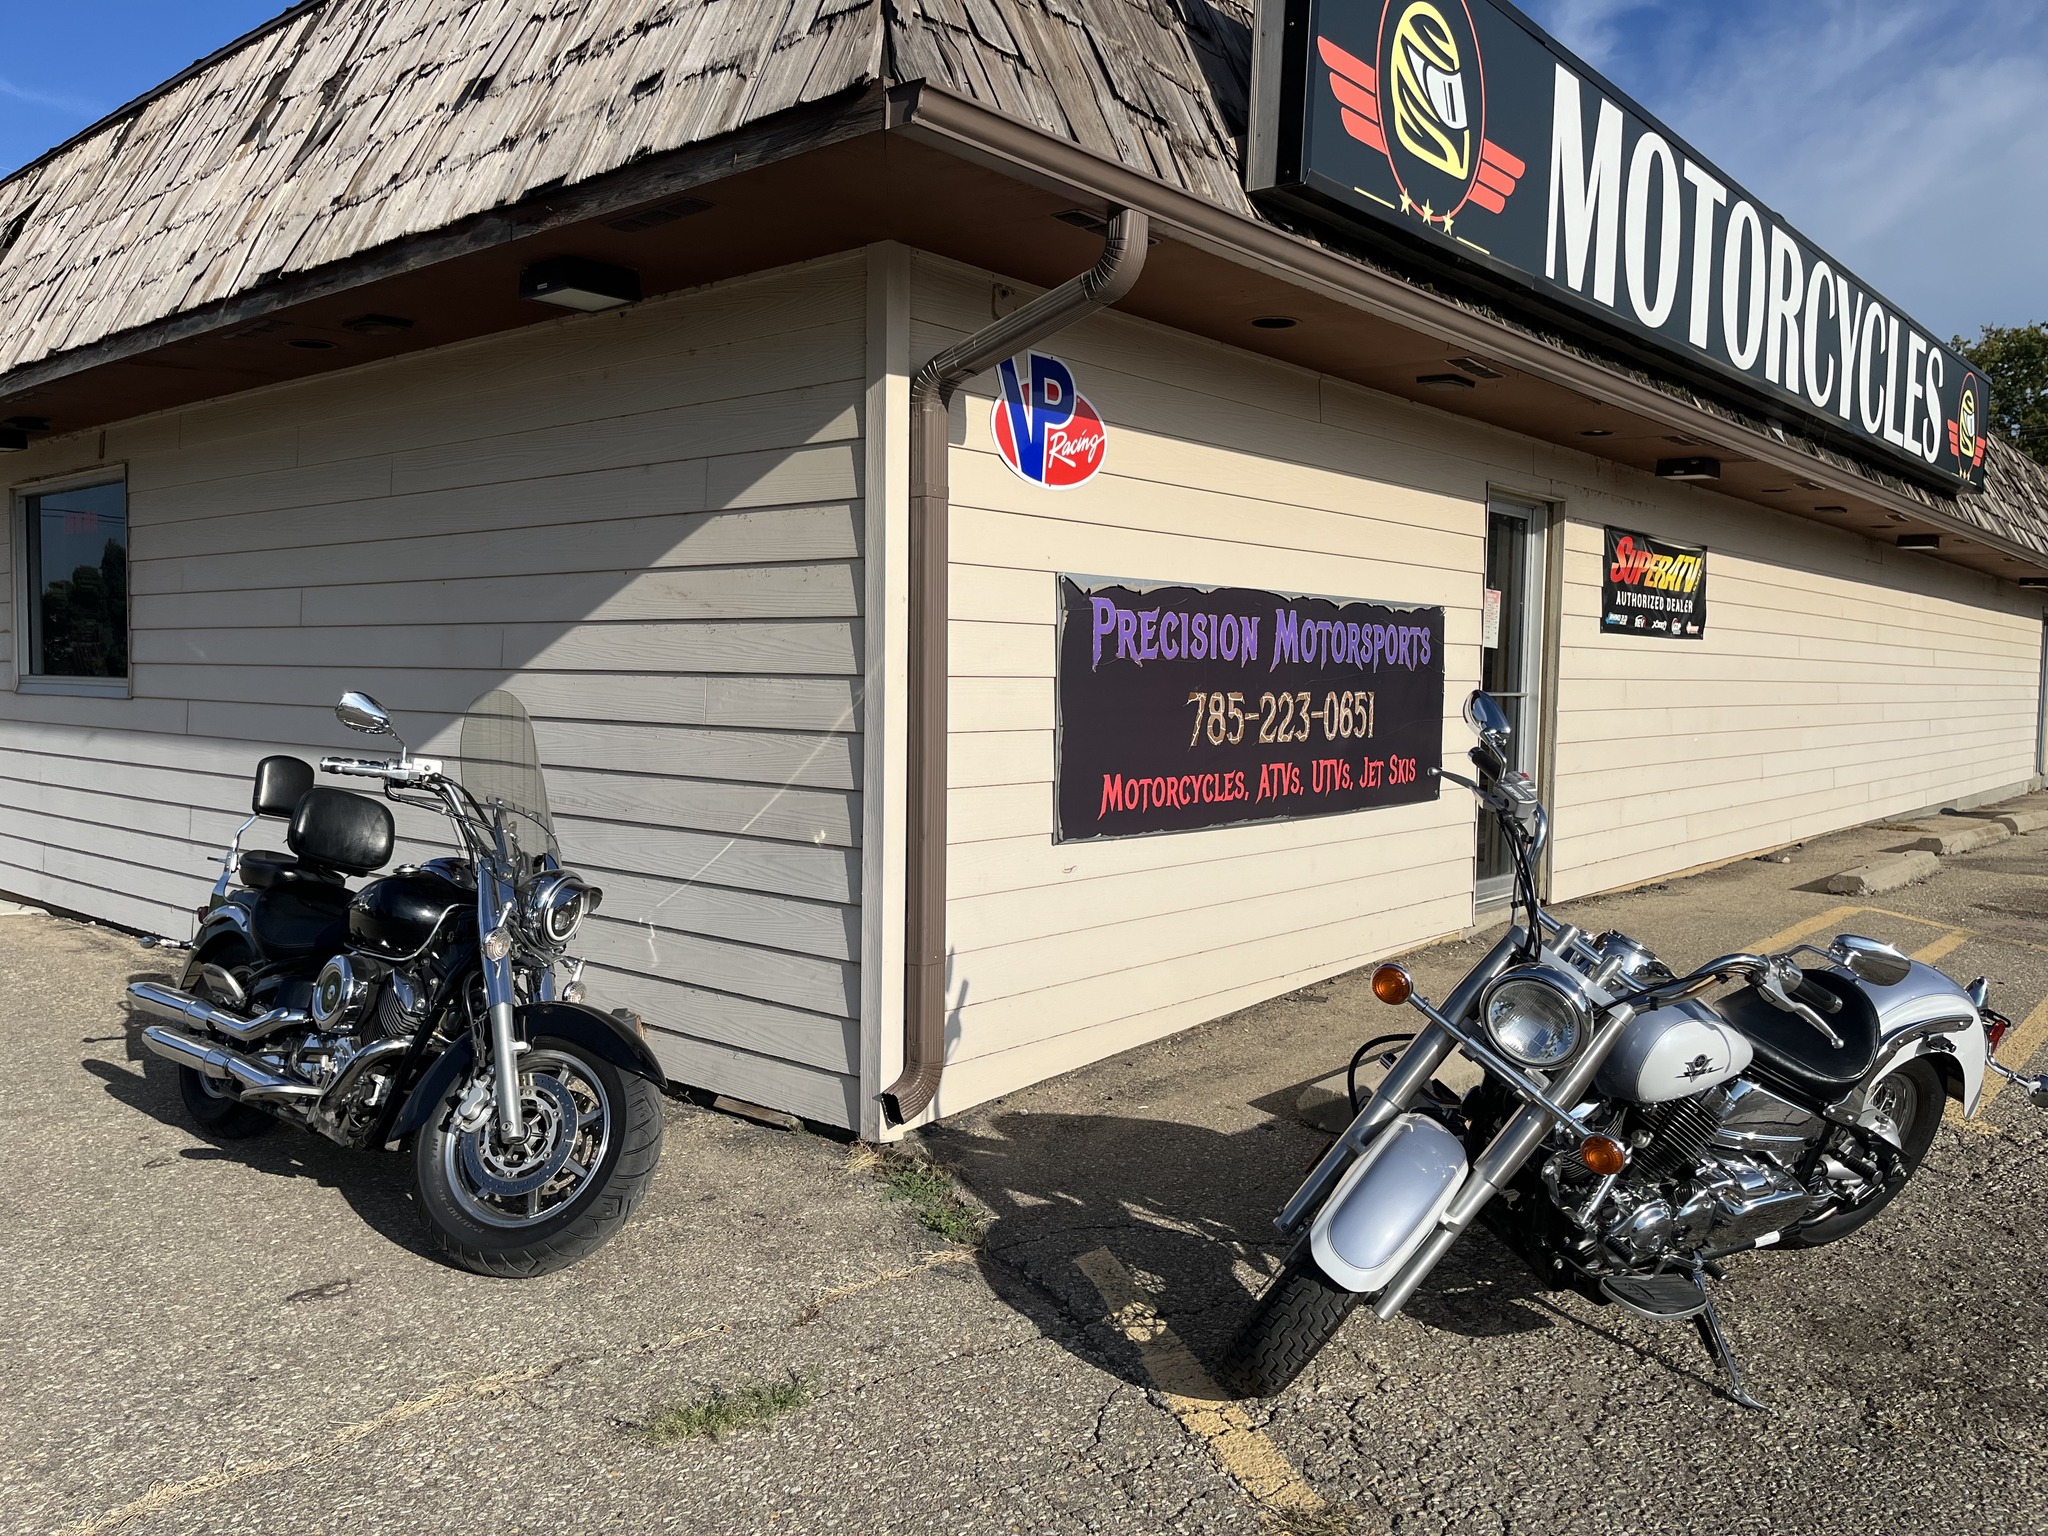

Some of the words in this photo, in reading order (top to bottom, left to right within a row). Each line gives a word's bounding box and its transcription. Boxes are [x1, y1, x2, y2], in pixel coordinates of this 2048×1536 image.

[1545, 63, 1943, 463] MOTORCYCLES
[1000, 354, 1075, 483] VP
[1048, 429, 1105, 469] Racing
[1089, 596, 1260, 672] PRECISION
[1268, 608, 1431, 674] MOTORSPORTS
[1616, 591, 1664, 611] AUTHORIZED
[1666, 597, 1693, 613] DEALER
[1186, 691, 1375, 749] 785-223-0651
[1098, 769, 1249, 821] MOTORCYCLES,
[1360, 756, 1385, 789] JET
[1388, 753, 1417, 786] SKIS
